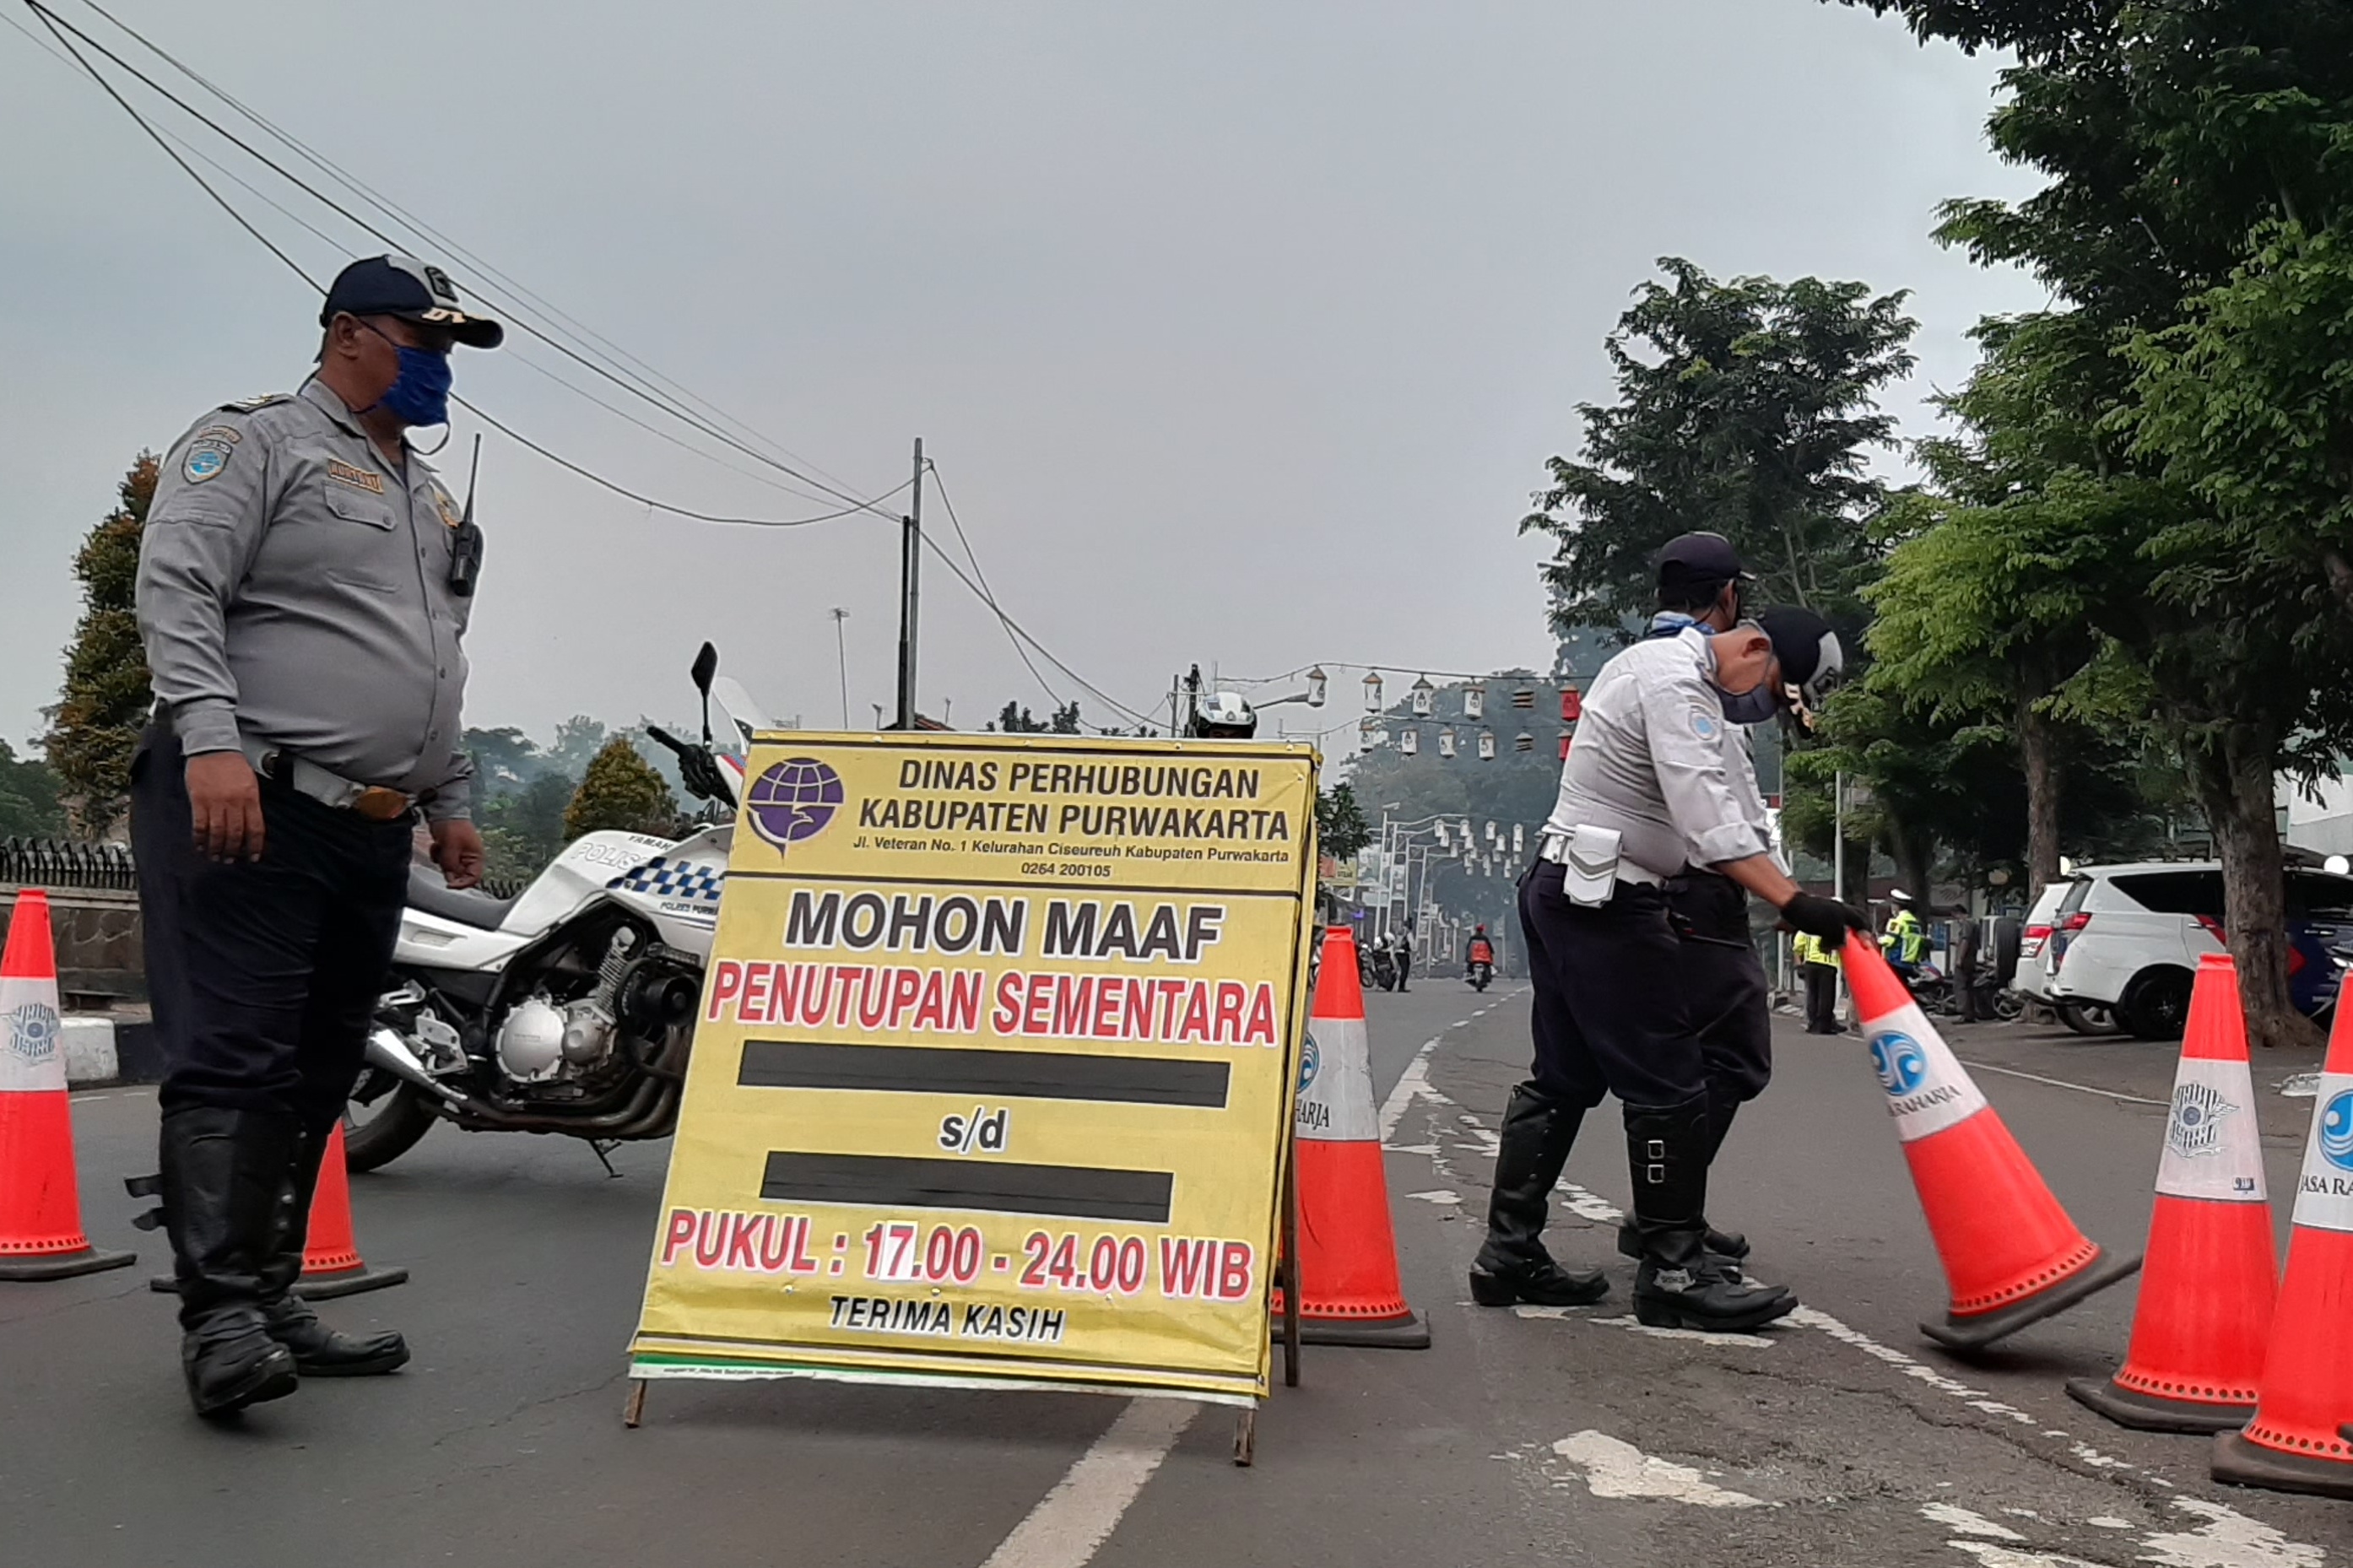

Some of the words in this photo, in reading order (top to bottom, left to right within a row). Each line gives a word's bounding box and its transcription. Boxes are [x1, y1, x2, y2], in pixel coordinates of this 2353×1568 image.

[899, 759, 998, 792] DINAS
[1009, 762, 1259, 799] PERHUBUNGAN
[859, 798, 1049, 834] KABUPATEN
[1058, 804, 1289, 841] PURWAKARTA
[571, 842, 648, 871] POLIS
[853, 836, 869, 849] Jl.
[874, 836, 927, 852] Veteran
[960, 841, 967, 852] 1
[972, 841, 1044, 855] Kelurahan
[1048, 842, 1122, 857] Ciseureuh
[1125, 846, 1203, 862] Kabupaten
[1207, 848, 1289, 862] Purwakarta
[1021, 862, 1055, 874] 0264
[1059, 863, 1112, 878] 200105
[786, 891, 1025, 954] MOHON
[1043, 901, 1223, 960] MAAF
[708, 961, 982, 1030] PENUTUPAN
[993, 972, 1275, 1045] SEMENTARA
[939, 1106, 1007, 1153] s/d
[2299, 1174, 2329, 1195] JASA
[663, 1208, 817, 1272] PUKUL
[865, 1223, 980, 1282] 17.00
[1020, 1231, 1144, 1292] 24.00
[1160, 1237, 1251, 1298] WIB
[830, 1295, 951, 1333] TERIMA
[961, 1304, 1064, 1340] KASIH
